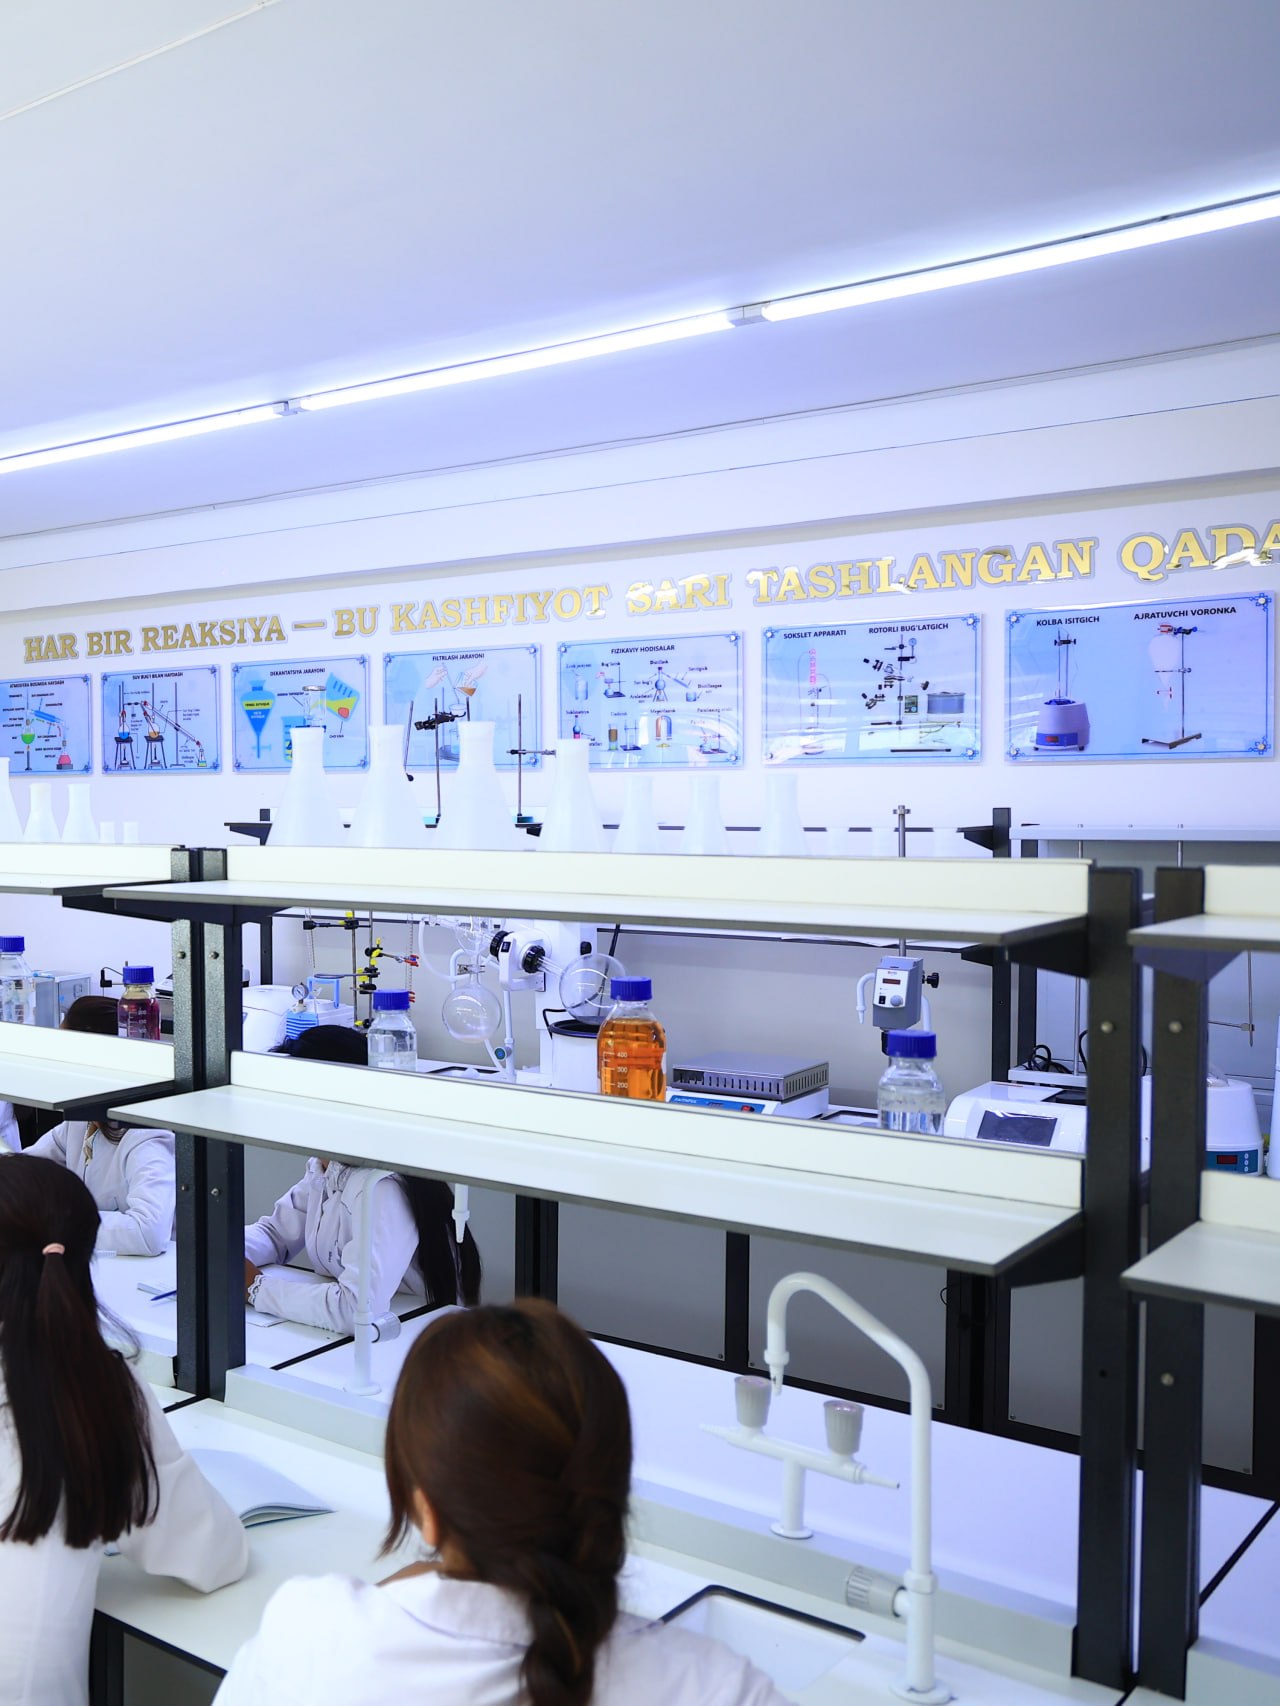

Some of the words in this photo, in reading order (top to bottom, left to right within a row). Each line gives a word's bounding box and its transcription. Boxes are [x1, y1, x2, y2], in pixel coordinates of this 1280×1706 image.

[23, 634, 78, 662] HAR
[86, 629, 133, 657] BIR
[141, 615, 287, 652] REAKSIYA
[333, 607, 379, 637] BU
[389, 584, 610, 633] KASHFIYOT
[625, 574, 730, 614] SARI
[746, 539, 1096, 604] TASHLANGAN
[1133, 608, 1188, 621] AJRATUVCHI
[1190, 606, 1237, 618] VORONKA
[1036, 617, 1063, 627] KOLBA
[1064, 615, 1100, 625] ISITGICH
[783, 631, 812, 640] SOKSLET
[813, 629, 847, 639] APPARATI
[868, 625, 899, 634] ROTORLI
[640, 645, 675, 653] HODISALAR
